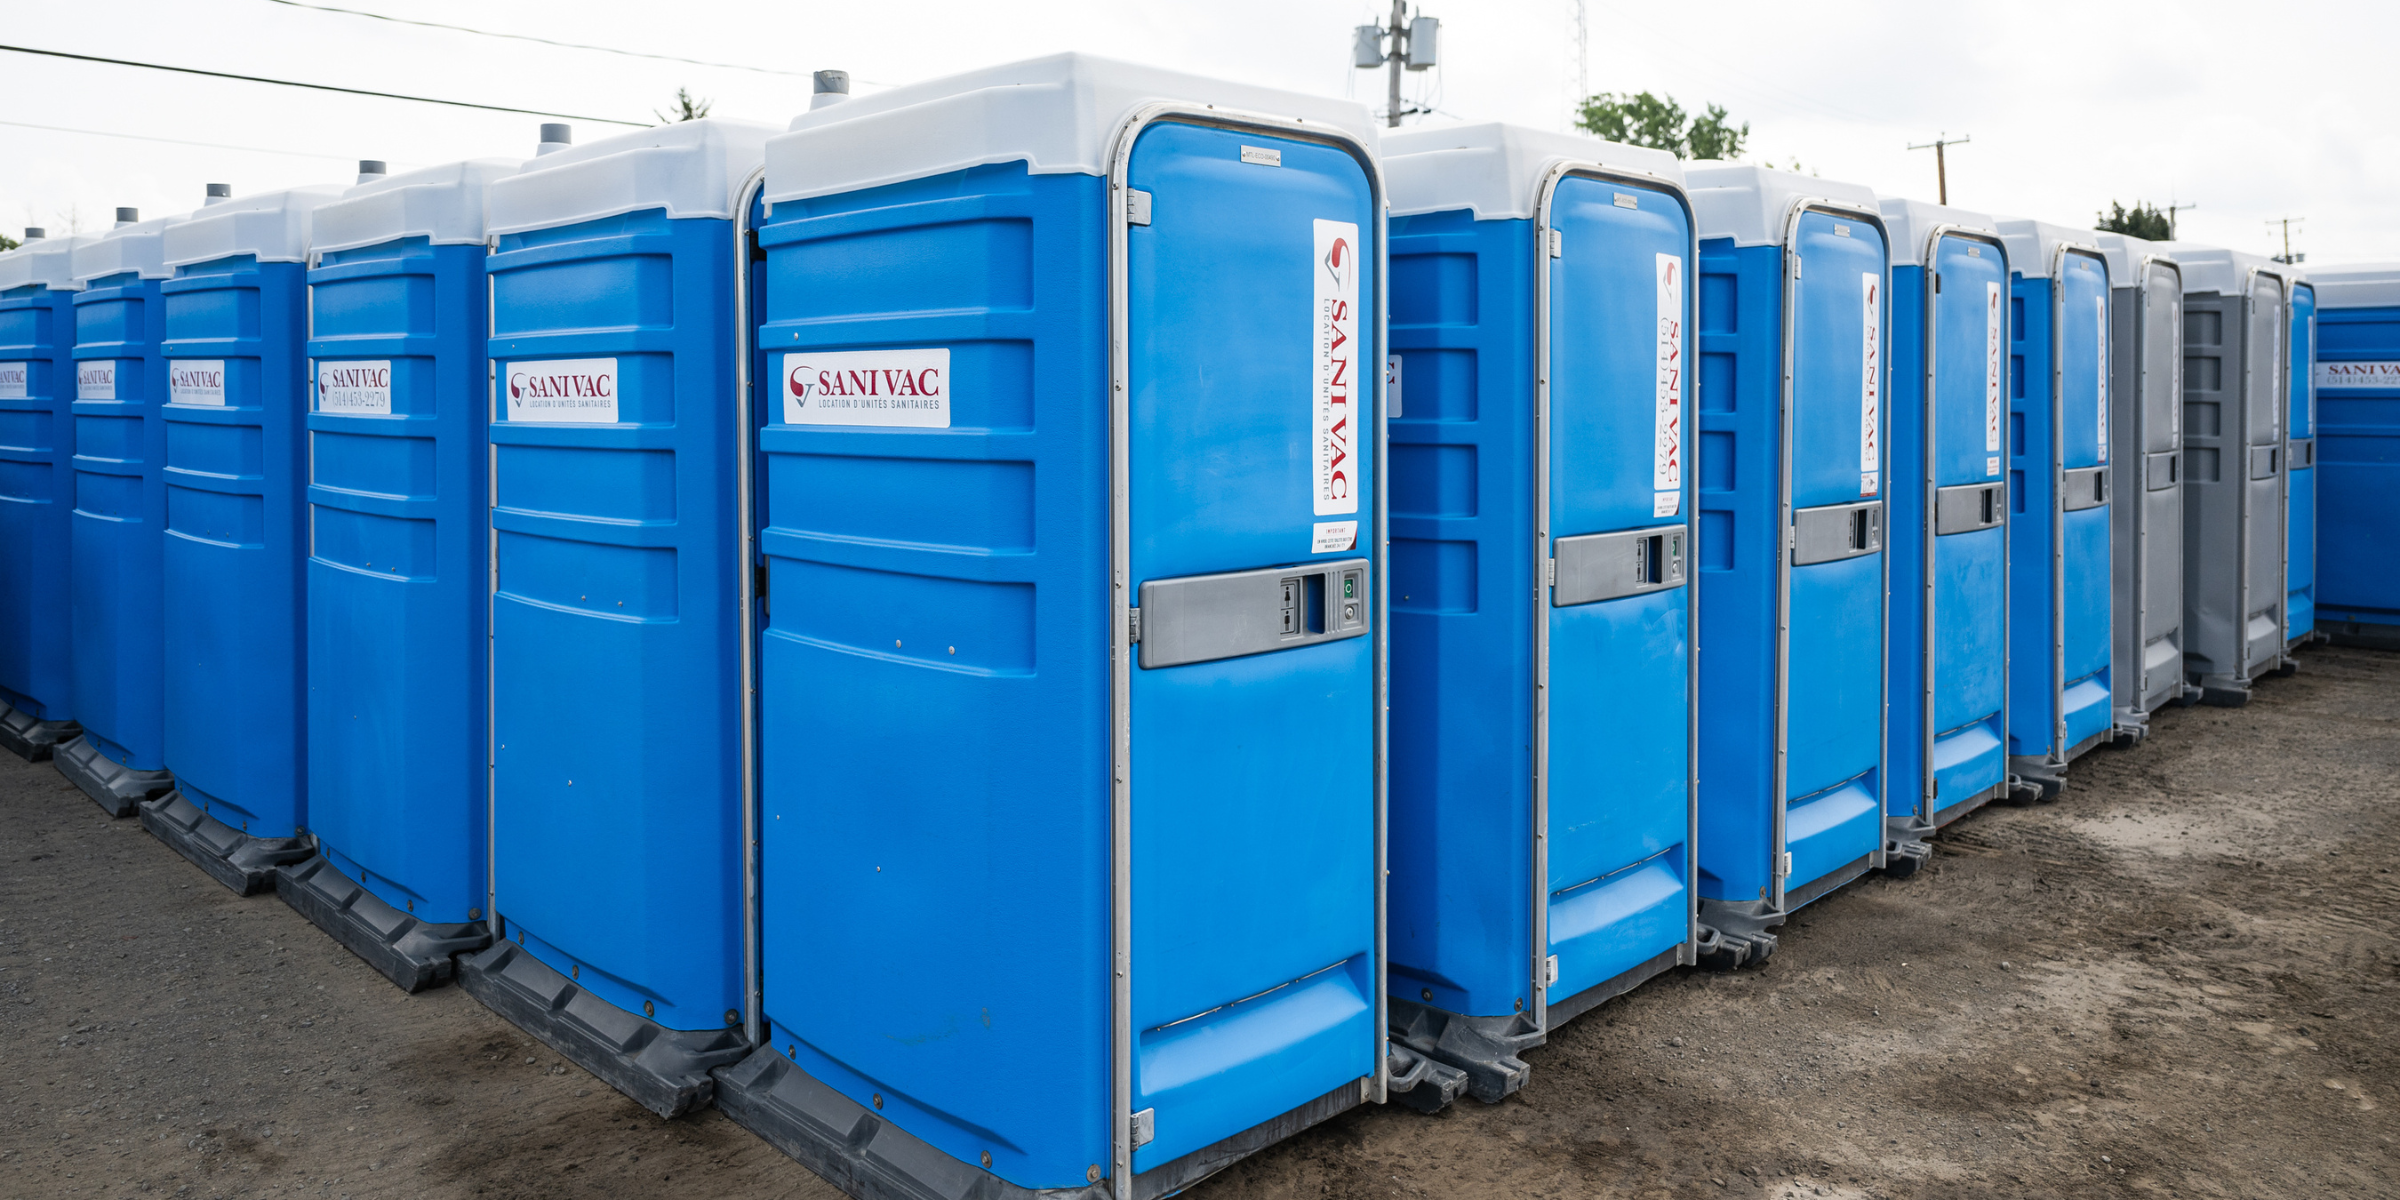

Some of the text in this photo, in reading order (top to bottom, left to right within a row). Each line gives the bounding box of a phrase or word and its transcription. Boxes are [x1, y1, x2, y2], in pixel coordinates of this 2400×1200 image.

[180, 371, 221, 388] SANI VAC
[332, 368, 389, 388] SANI VAC
[2328, 365, 2375, 375] SANI
[529, 374, 611, 398] SANI VAC
[819, 368, 939, 396] SANI VAC
[332, 390, 386, 408] (514)453-2279
[529, 400, 551, 408] LOCATION
[578, 400, 611, 408] SANITAIRES
[819, 397, 940, 410] LOCATION D'UNITÉS SANITAIRES
[1331, 299, 1347, 500] SANI VAC
[1668, 321, 1679, 482] SANI VAC
